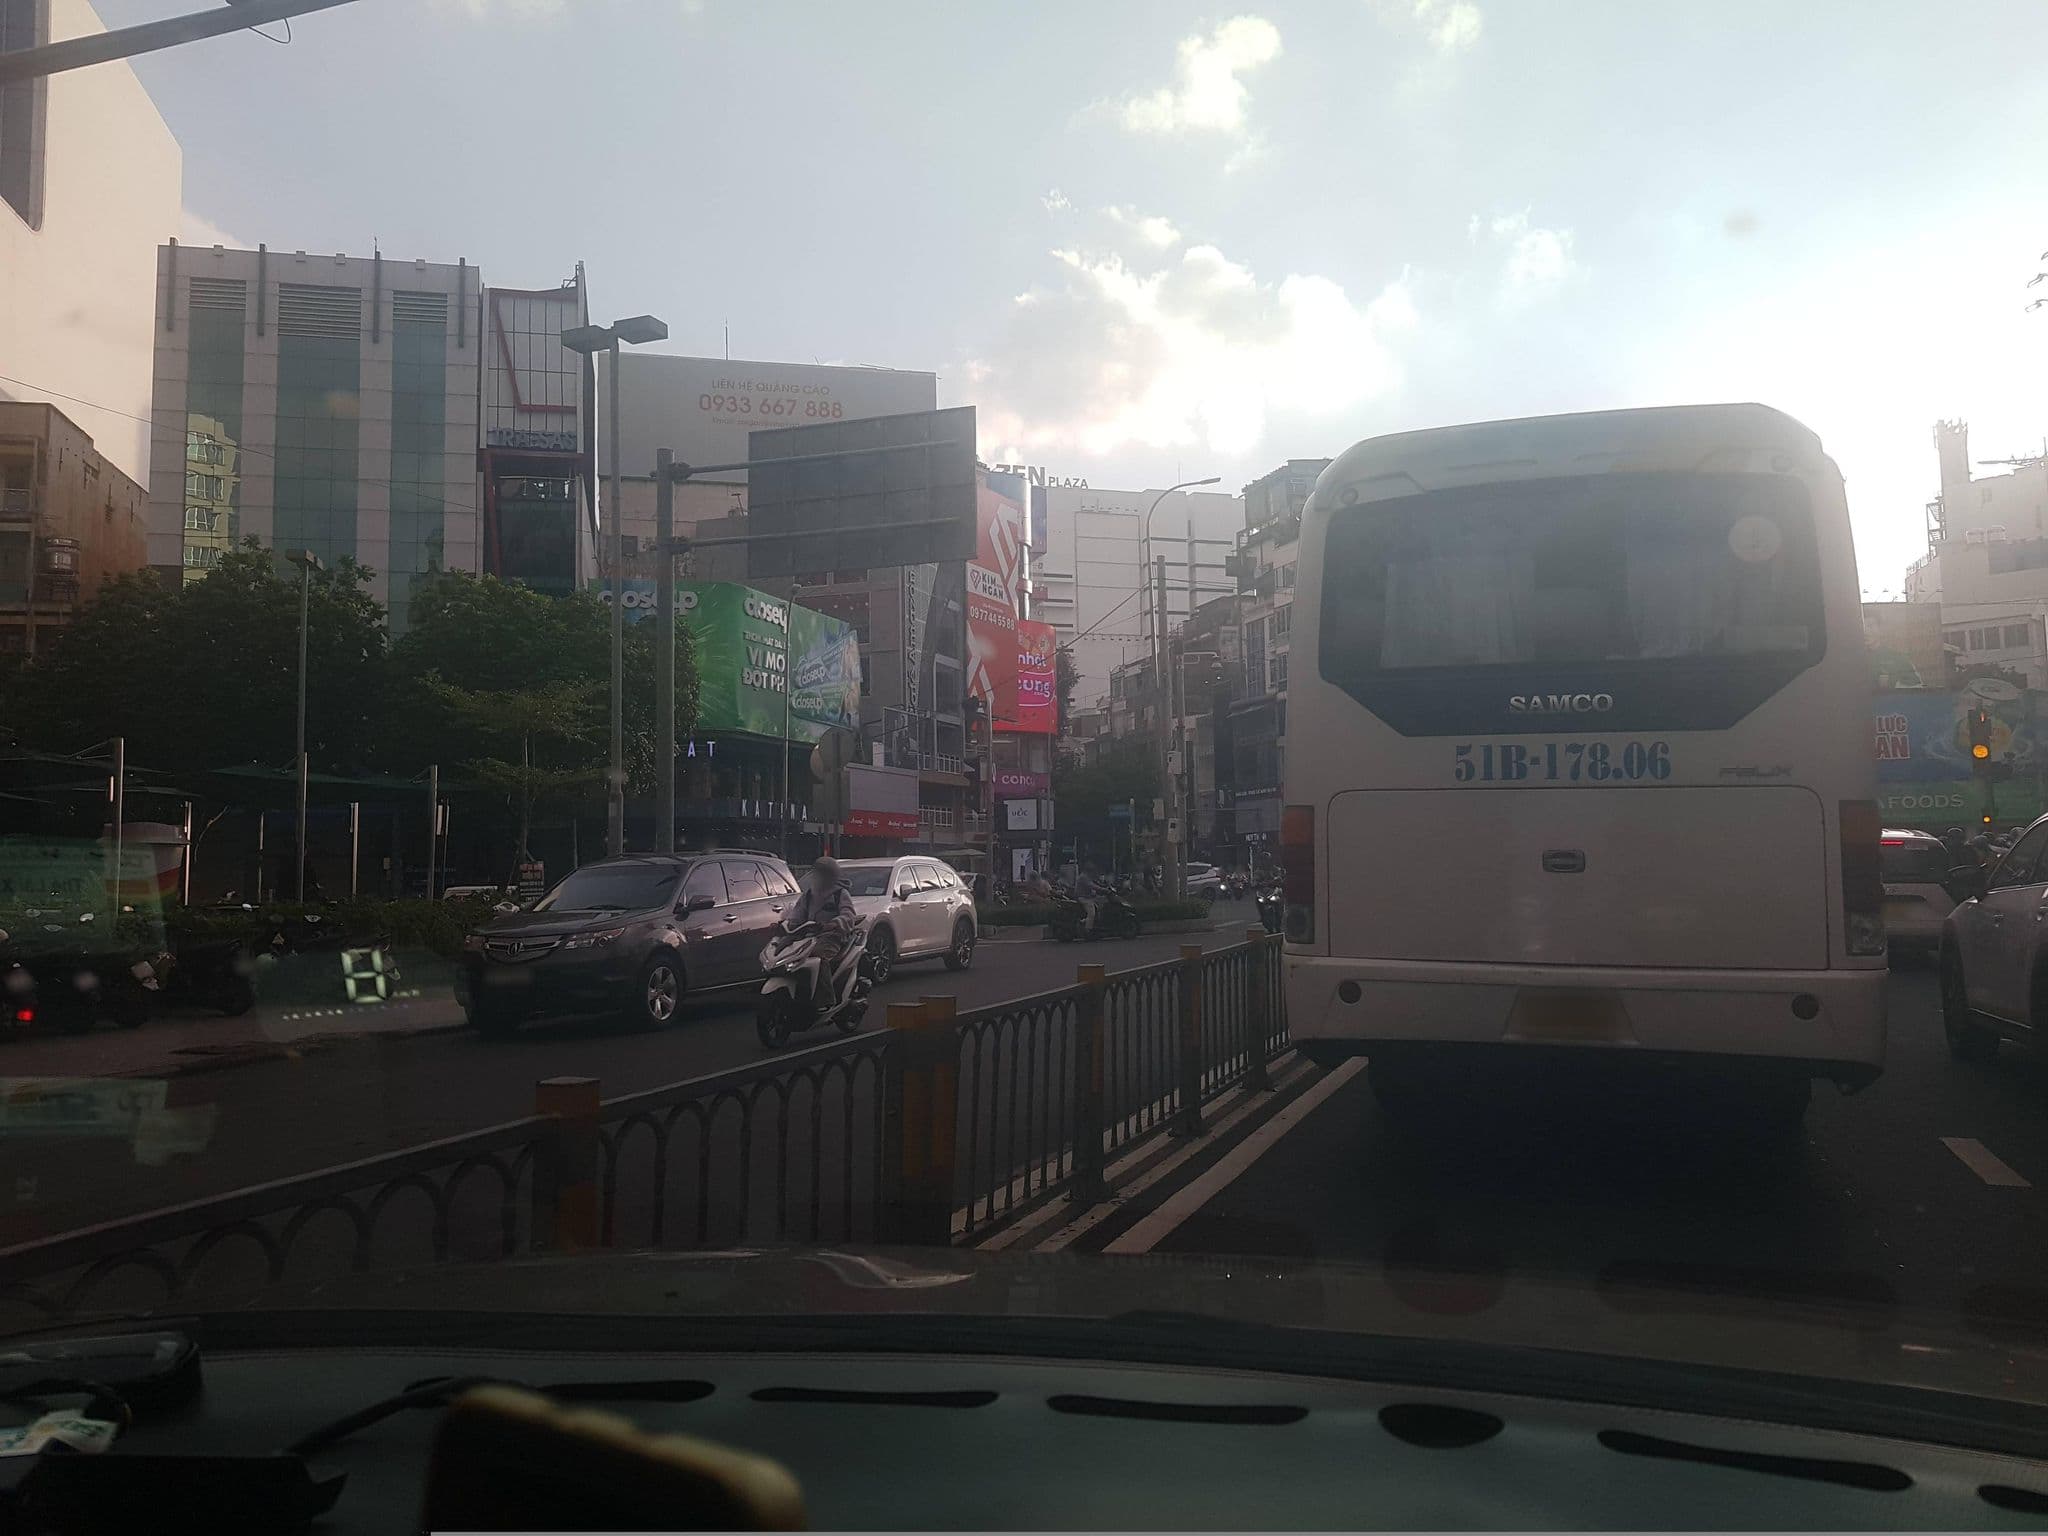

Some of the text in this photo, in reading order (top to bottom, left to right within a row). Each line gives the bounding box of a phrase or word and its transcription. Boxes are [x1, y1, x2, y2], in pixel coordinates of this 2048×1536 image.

[699, 393, 844, 419] 0933 667 888
[1048, 476, 1088, 489] PLAZA
[982, 571, 997, 586] KIM
[1509, 693, 1614, 713] SAMCO
[1455, 741, 1672, 782] 51B-178.06
[341, 947, 388, 1004] 8
